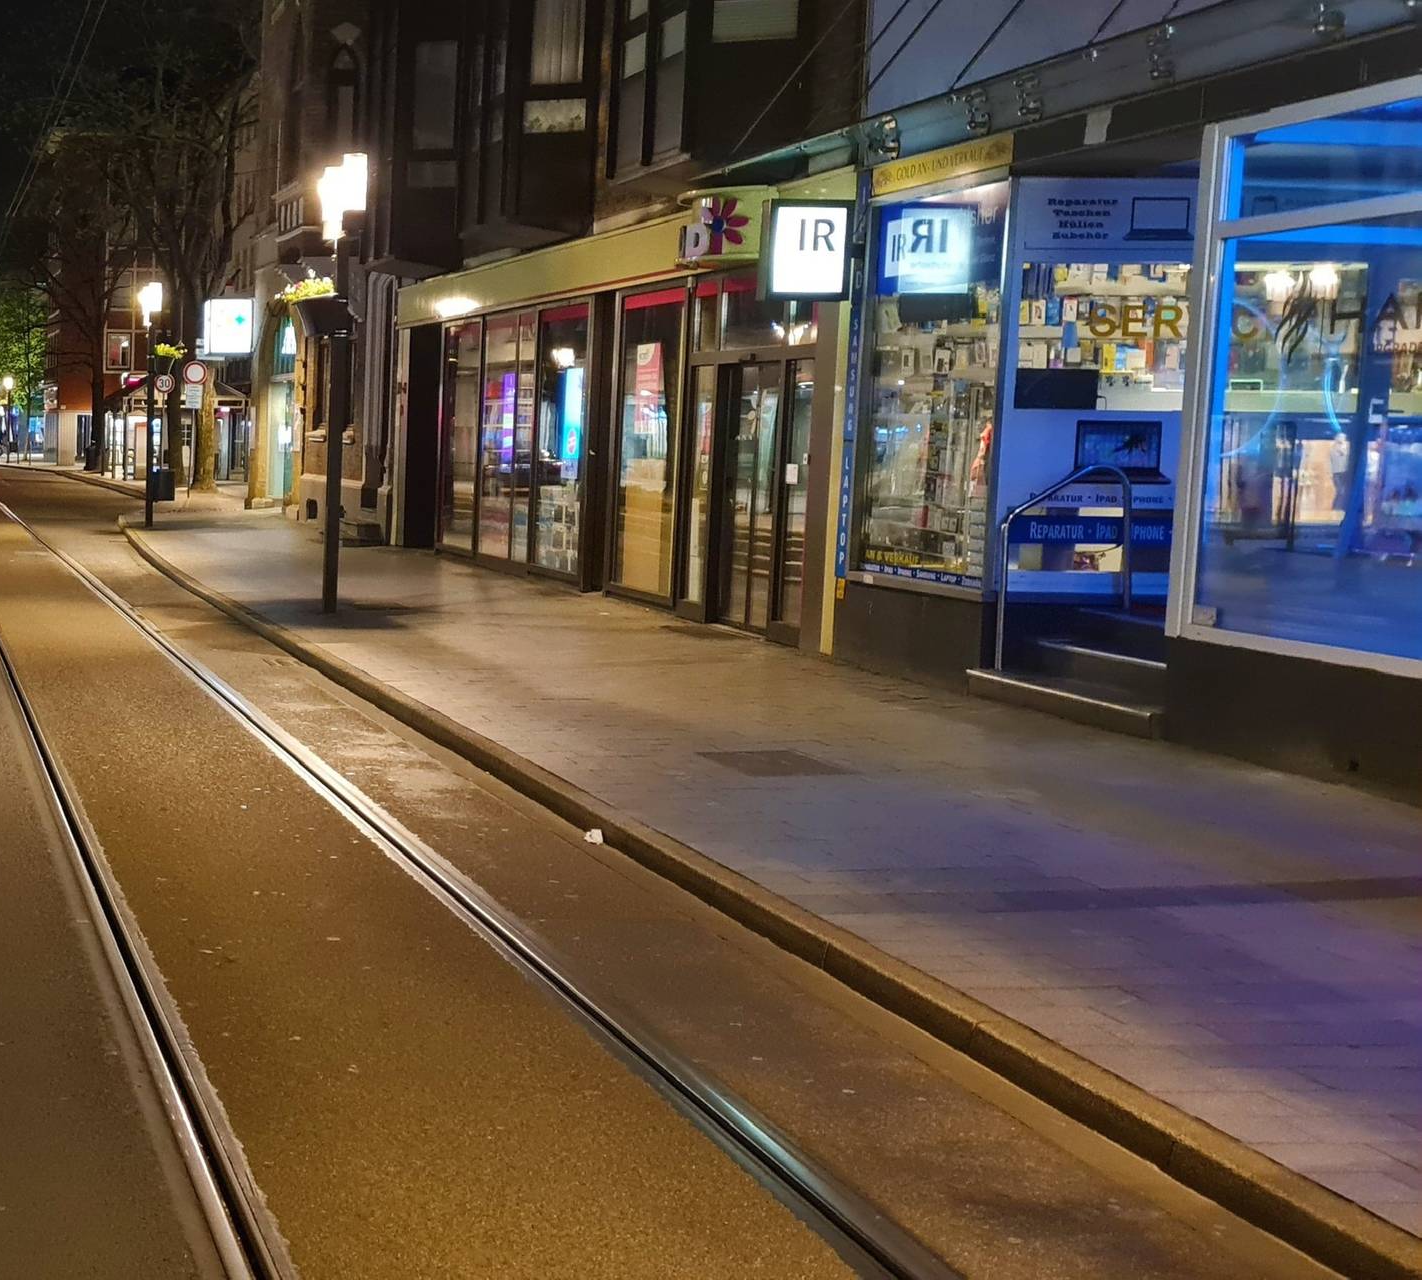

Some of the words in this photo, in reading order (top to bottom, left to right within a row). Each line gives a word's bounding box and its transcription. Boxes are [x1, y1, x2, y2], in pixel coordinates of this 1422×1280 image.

[1052, 209, 1111, 217] Taschen
[799, 218, 835, 251] IR
[159, 379, 170, 389] 30
[838, 457, 850, 566] LAPTOP
[1029, 521, 1085, 539] REPARATUR
